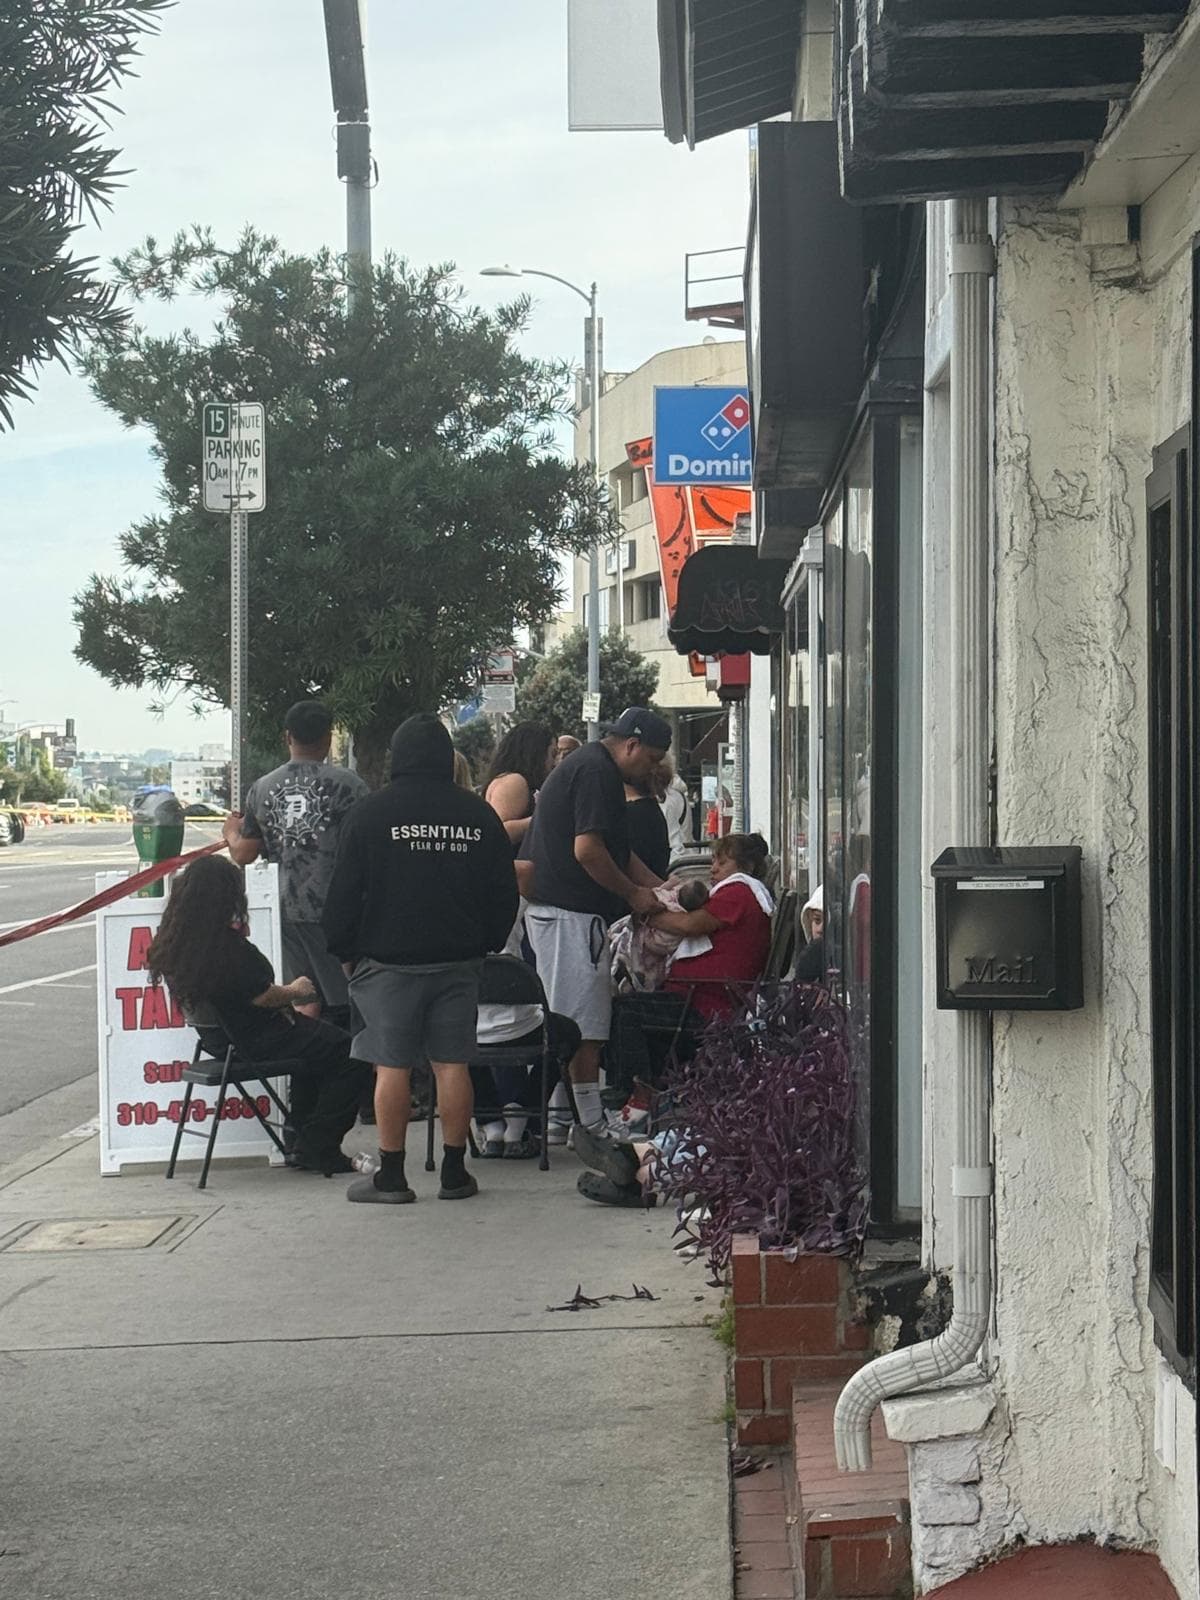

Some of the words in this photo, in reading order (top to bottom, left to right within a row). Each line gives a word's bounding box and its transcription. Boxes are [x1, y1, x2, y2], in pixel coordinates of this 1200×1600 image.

[209, 409, 225, 433] 15
[208, 439, 261, 459] PARKING
[391, 824, 482, 841] ESSENTIALS
[410, 841, 431, 851] FEAR
[435, 841, 447, 851] OF
[450, 843, 468, 852] GOD
[963, 953, 1037, 985] Mail
